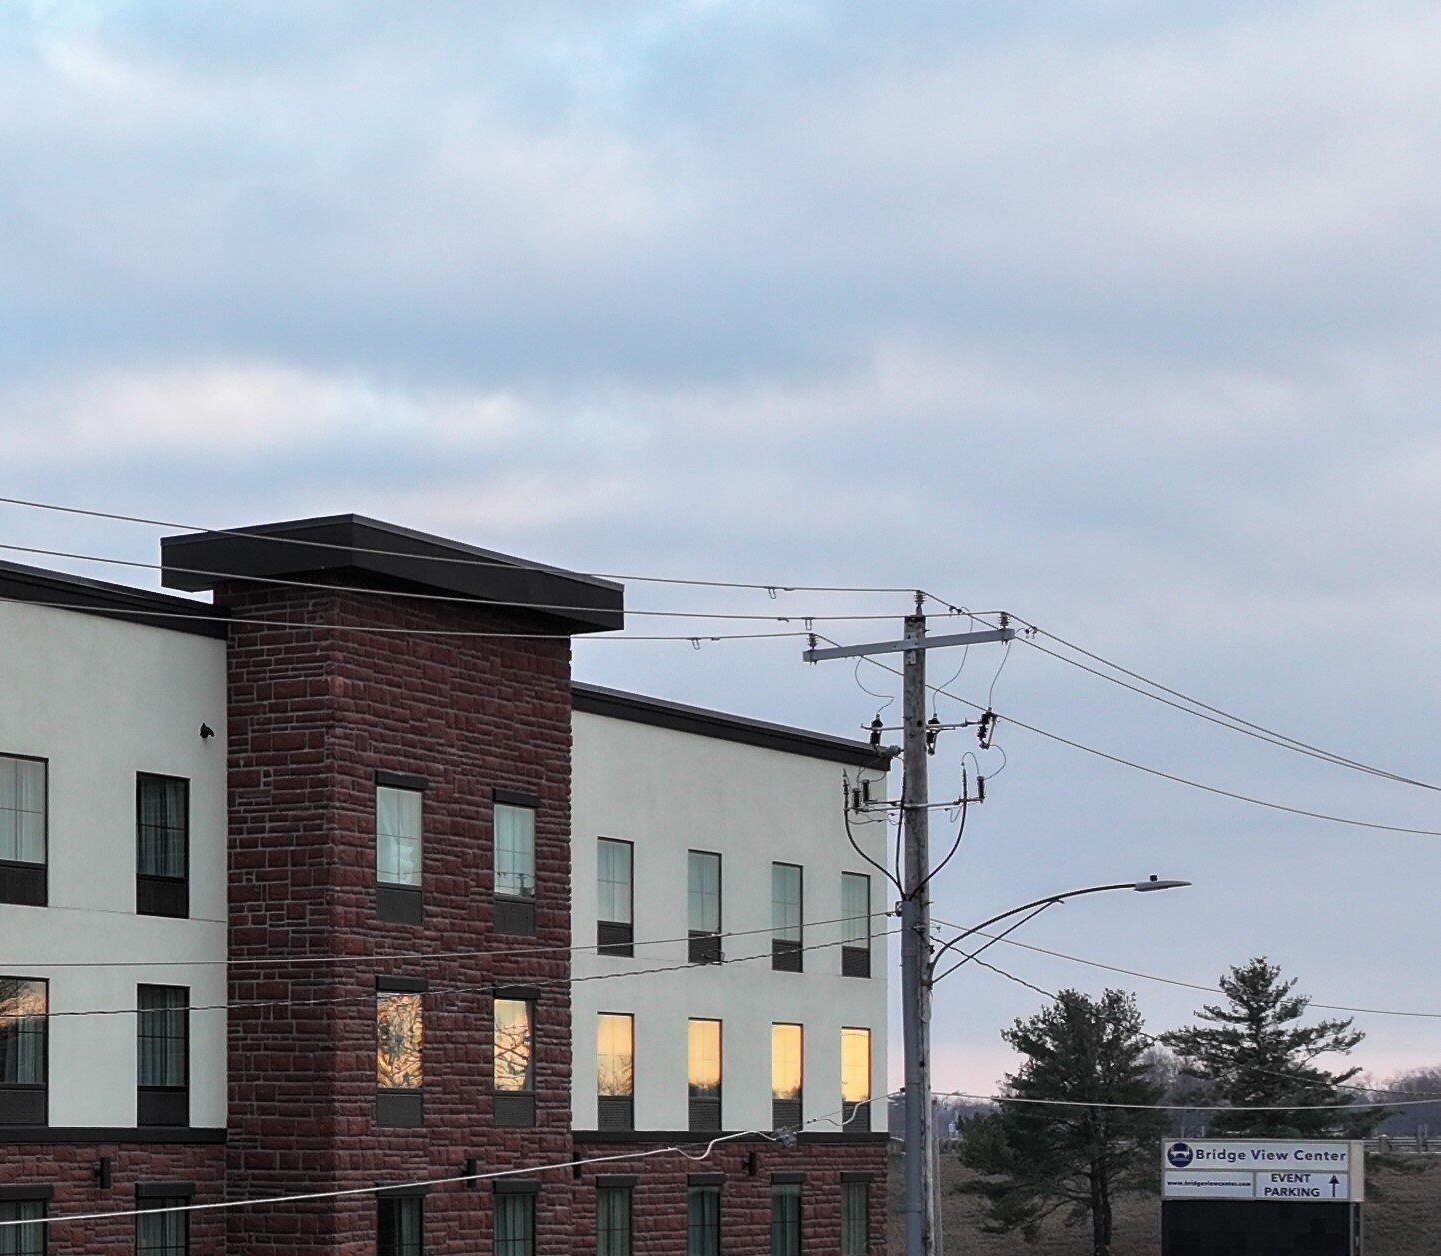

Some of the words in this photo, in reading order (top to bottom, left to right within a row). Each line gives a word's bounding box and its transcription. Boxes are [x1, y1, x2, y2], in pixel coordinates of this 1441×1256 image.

[1196, 1149, 1247, 1163] Bridge
[1250, 1149, 1289, 1161] View
[1293, 1149, 1347, 1161] Center
[1271, 1173, 1311, 1183] EVENT
[1264, 1187, 1320, 1198] PARKING
